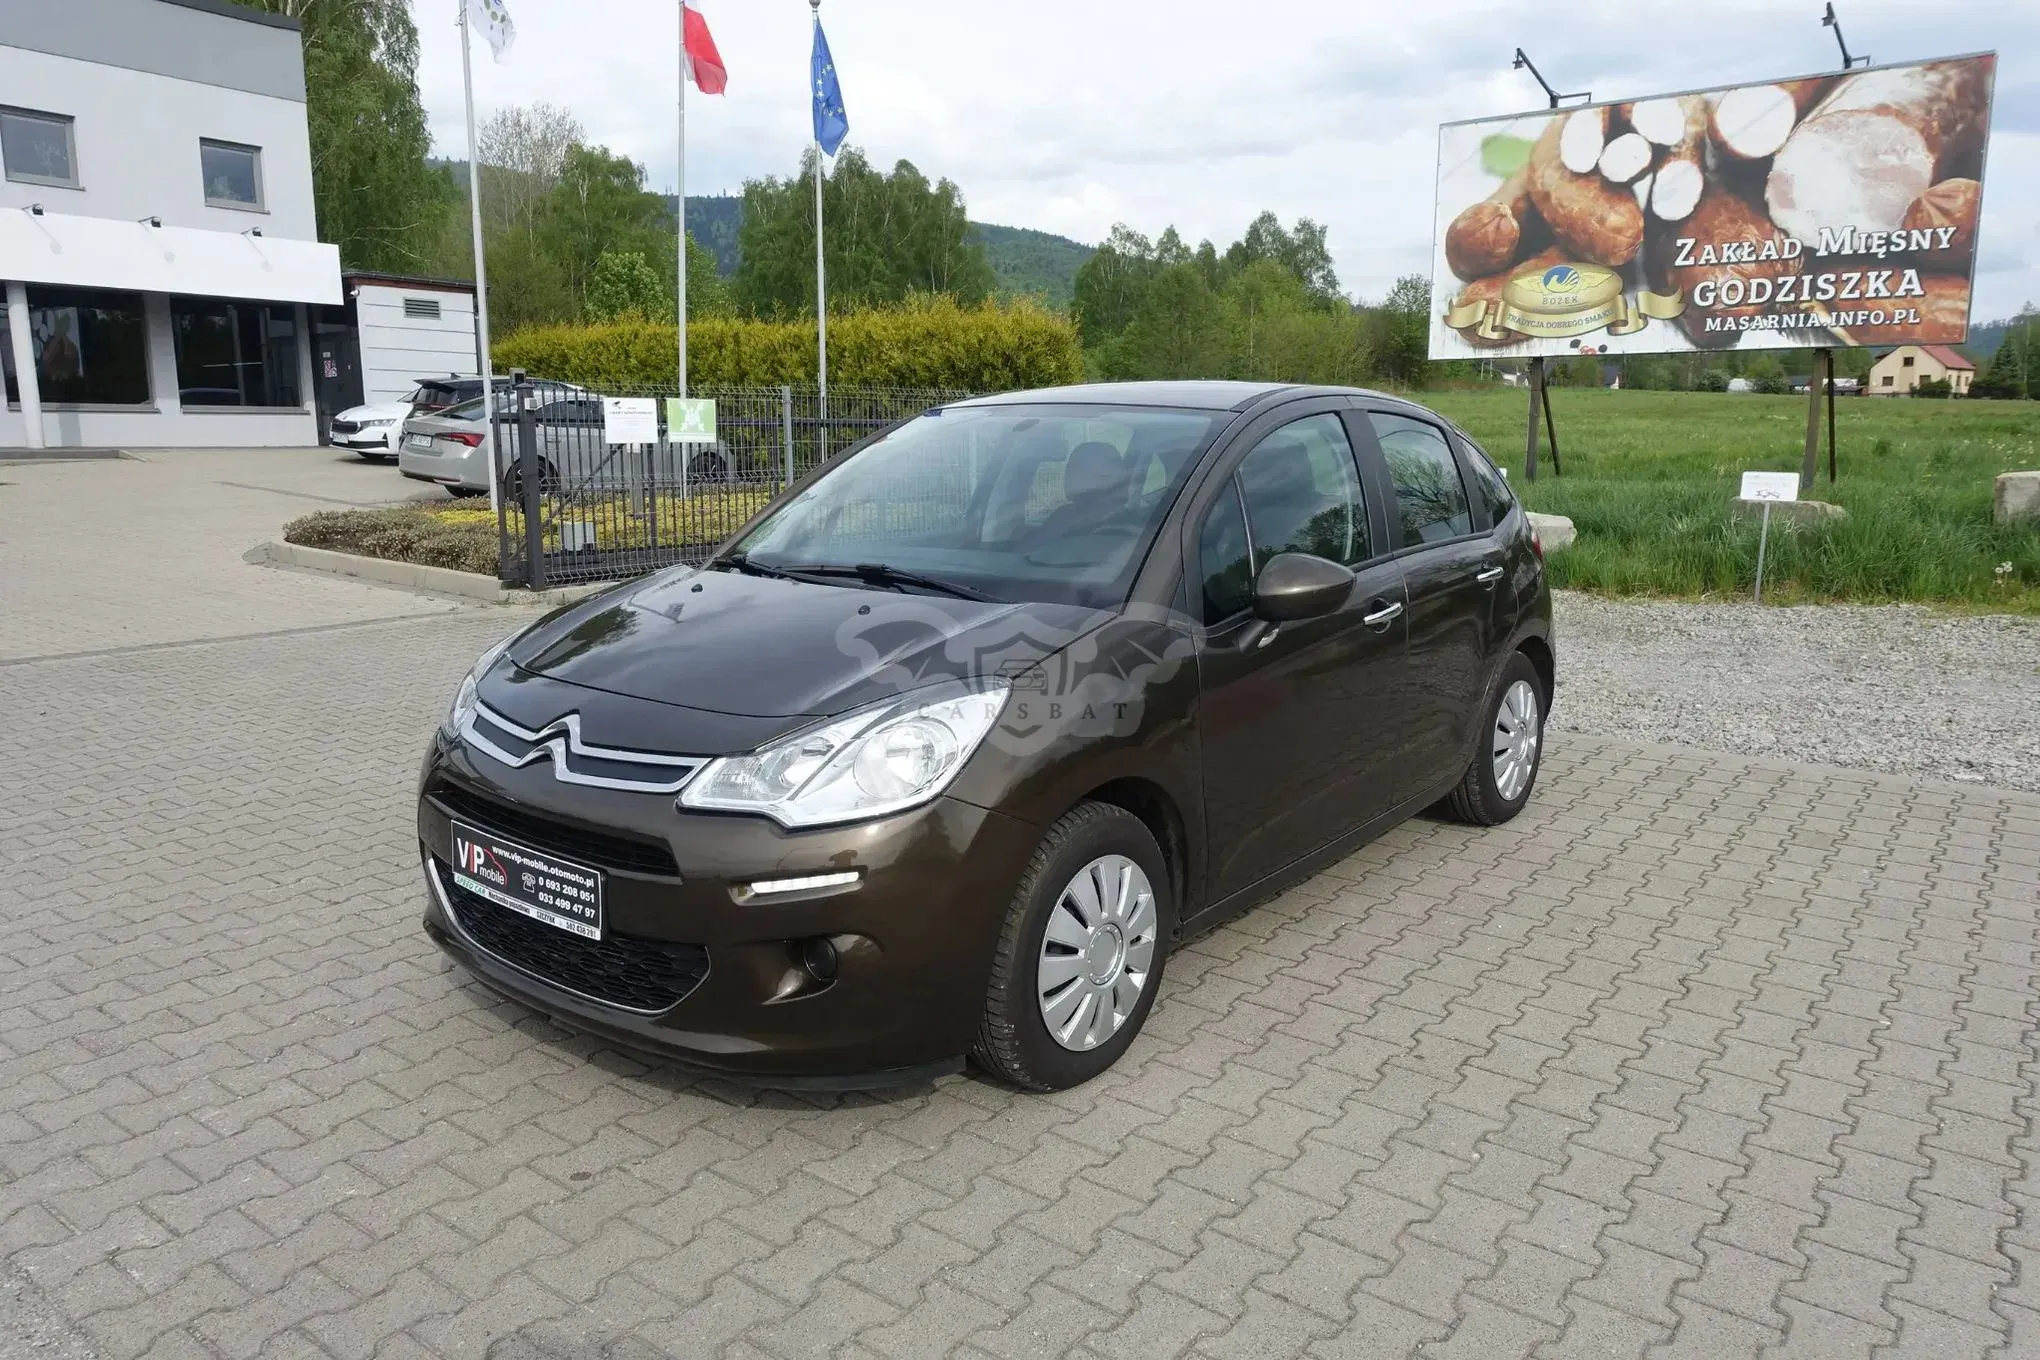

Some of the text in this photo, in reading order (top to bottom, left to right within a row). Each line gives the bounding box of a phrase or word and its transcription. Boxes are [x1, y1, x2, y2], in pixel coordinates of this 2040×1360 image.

[1674, 225, 1957, 267] ZAKŁAD MIĘSNY
[1693, 268, 1925, 307] GODZISZKA
[1507, 313, 1544, 328] TRADYCJA
[1546, 319, 1583, 329] DOBREGO
[1704, 308, 1921, 332] MASARNIA.INFO.PL
[457, 837, 485, 873] VIP
[492, 845, 594, 888] www.vip-mobile.otomoto.pl
[479, 866, 505, 885] mobile
[538, 876, 594, 903] 0 693 208 051
[538, 892, 595, 919] 033 499 47 97
